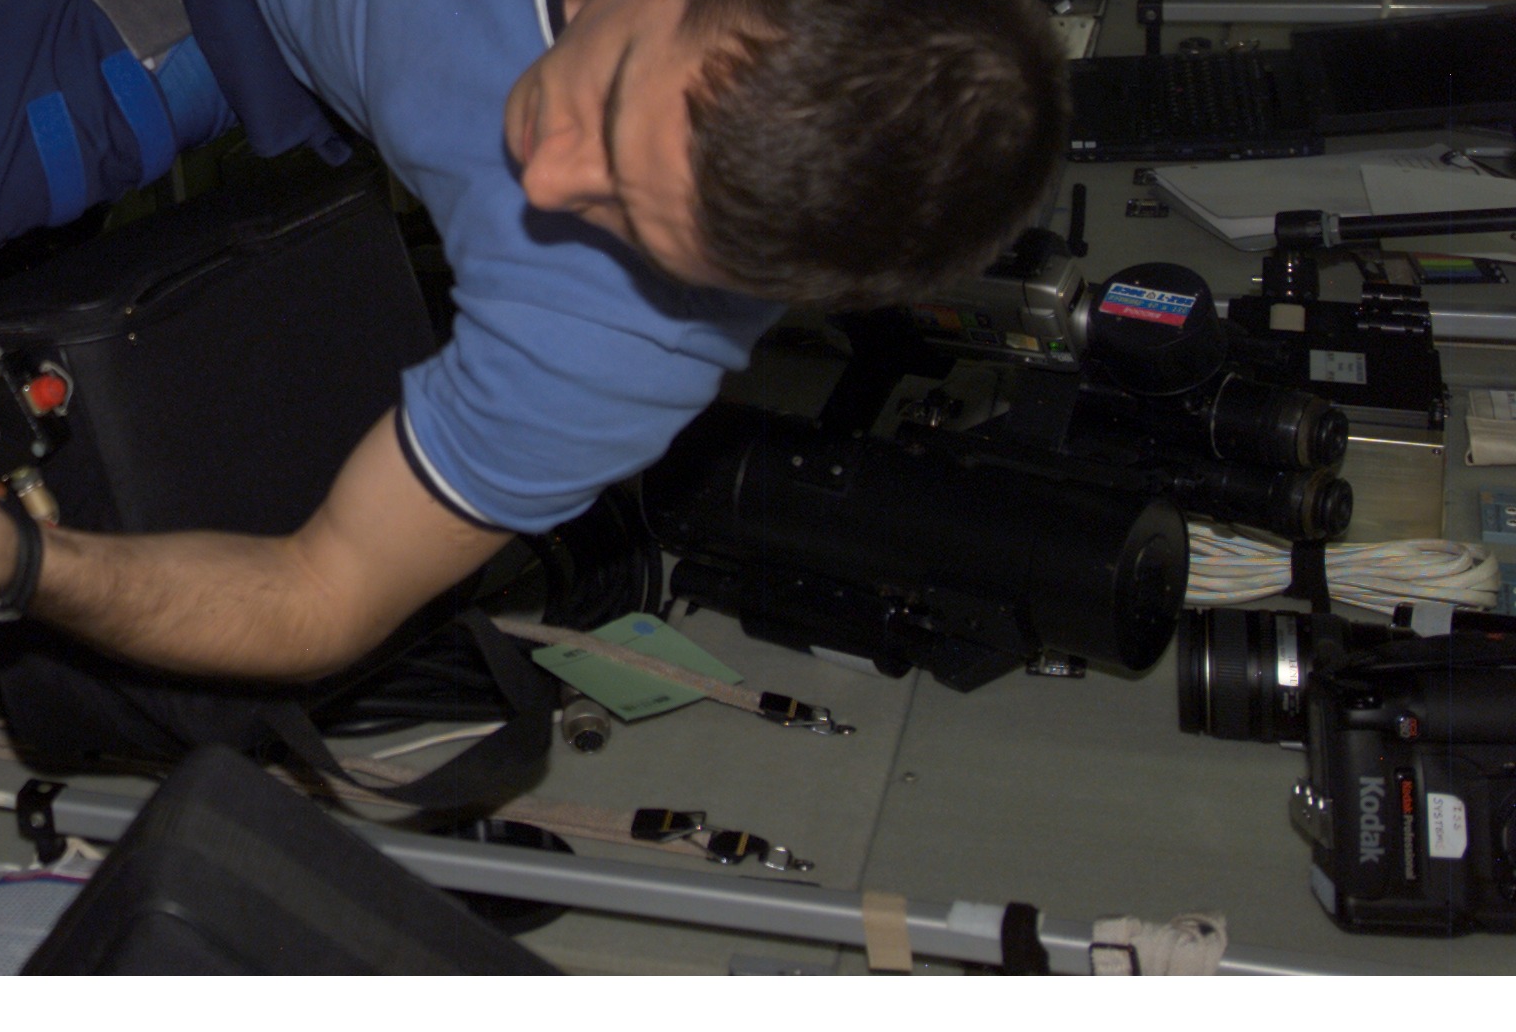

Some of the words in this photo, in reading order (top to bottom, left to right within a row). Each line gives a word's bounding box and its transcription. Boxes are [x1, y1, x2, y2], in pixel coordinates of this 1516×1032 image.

[1359, 776, 1386, 864] Kodak
[1402, 780, 1413, 814] Kodak
[1452, 805, 1463, 831] ISS
[1402, 815, 1416, 880] Professional
